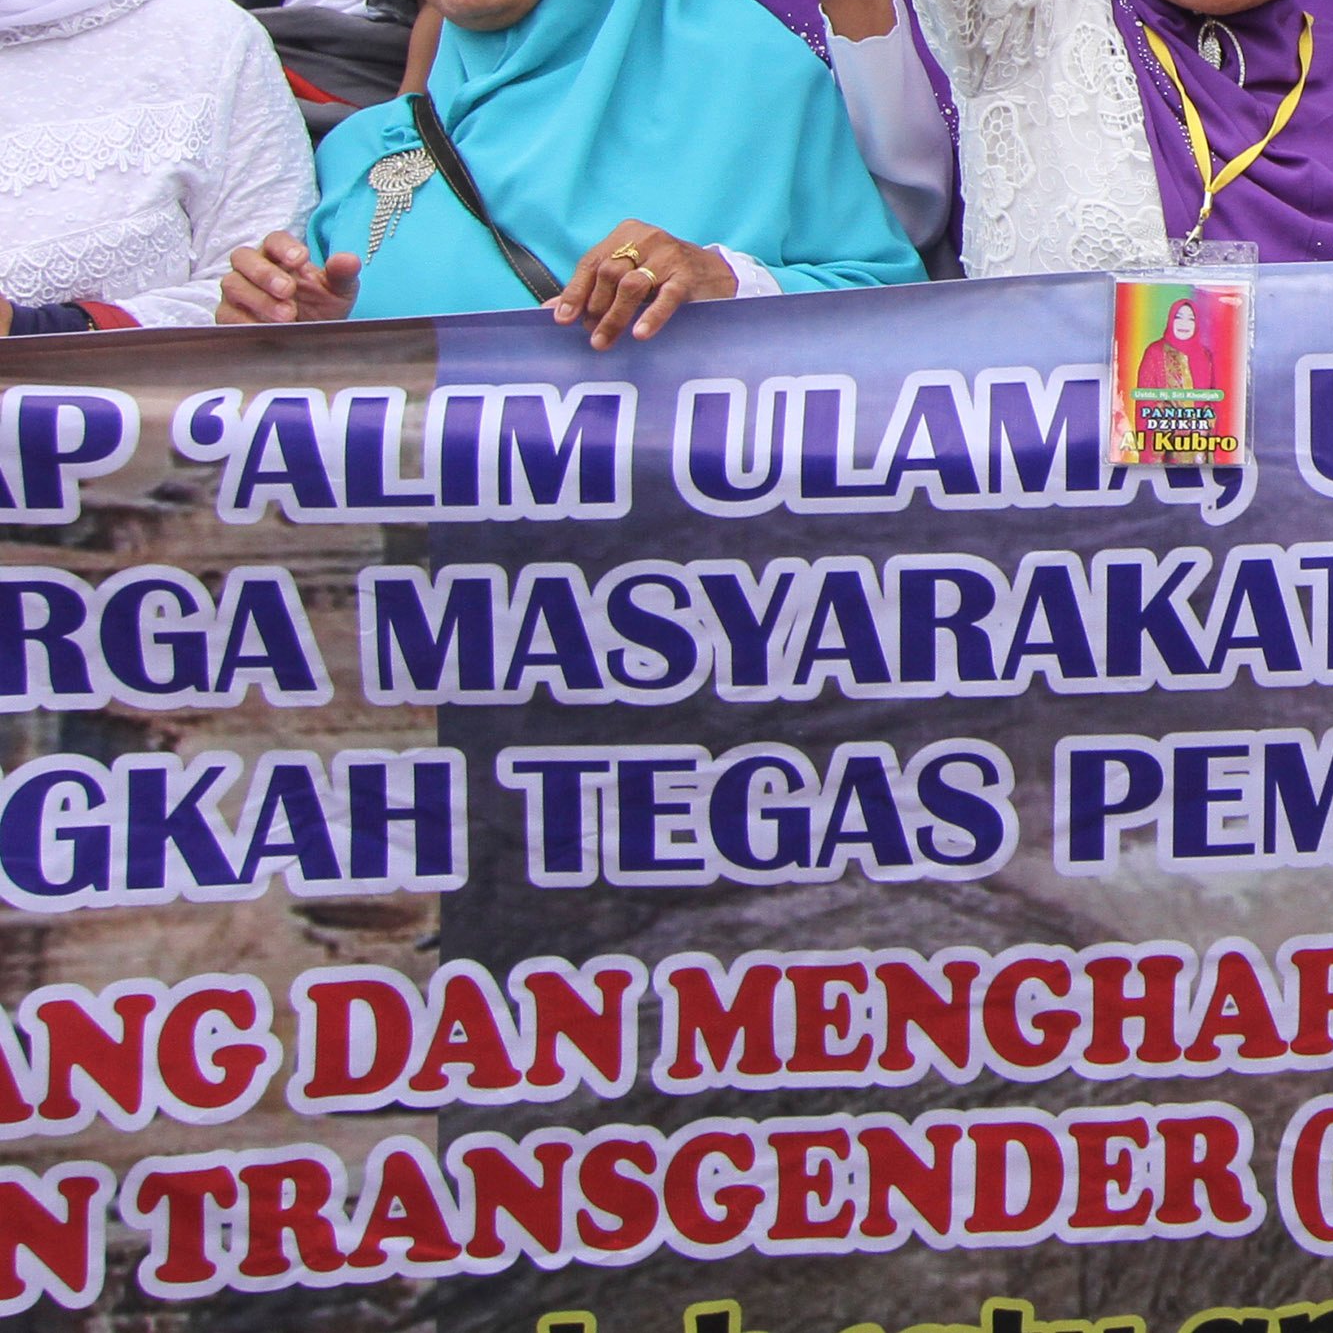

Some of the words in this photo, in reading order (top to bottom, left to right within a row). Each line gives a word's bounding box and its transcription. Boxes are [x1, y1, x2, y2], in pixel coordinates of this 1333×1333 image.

[1120, 431, 1145, 451] Al
[1154, 431, 1238, 452] Kubro
[1142, 407, 1215, 418] PANITIA
[1147, 419, 1209, 430] DZIKIR
[511, 751, 1010, 873] TEGAS
[305, 969, 634, 1097] DAN
[137, 1115, 1263, 1284] TRANSGENDER
